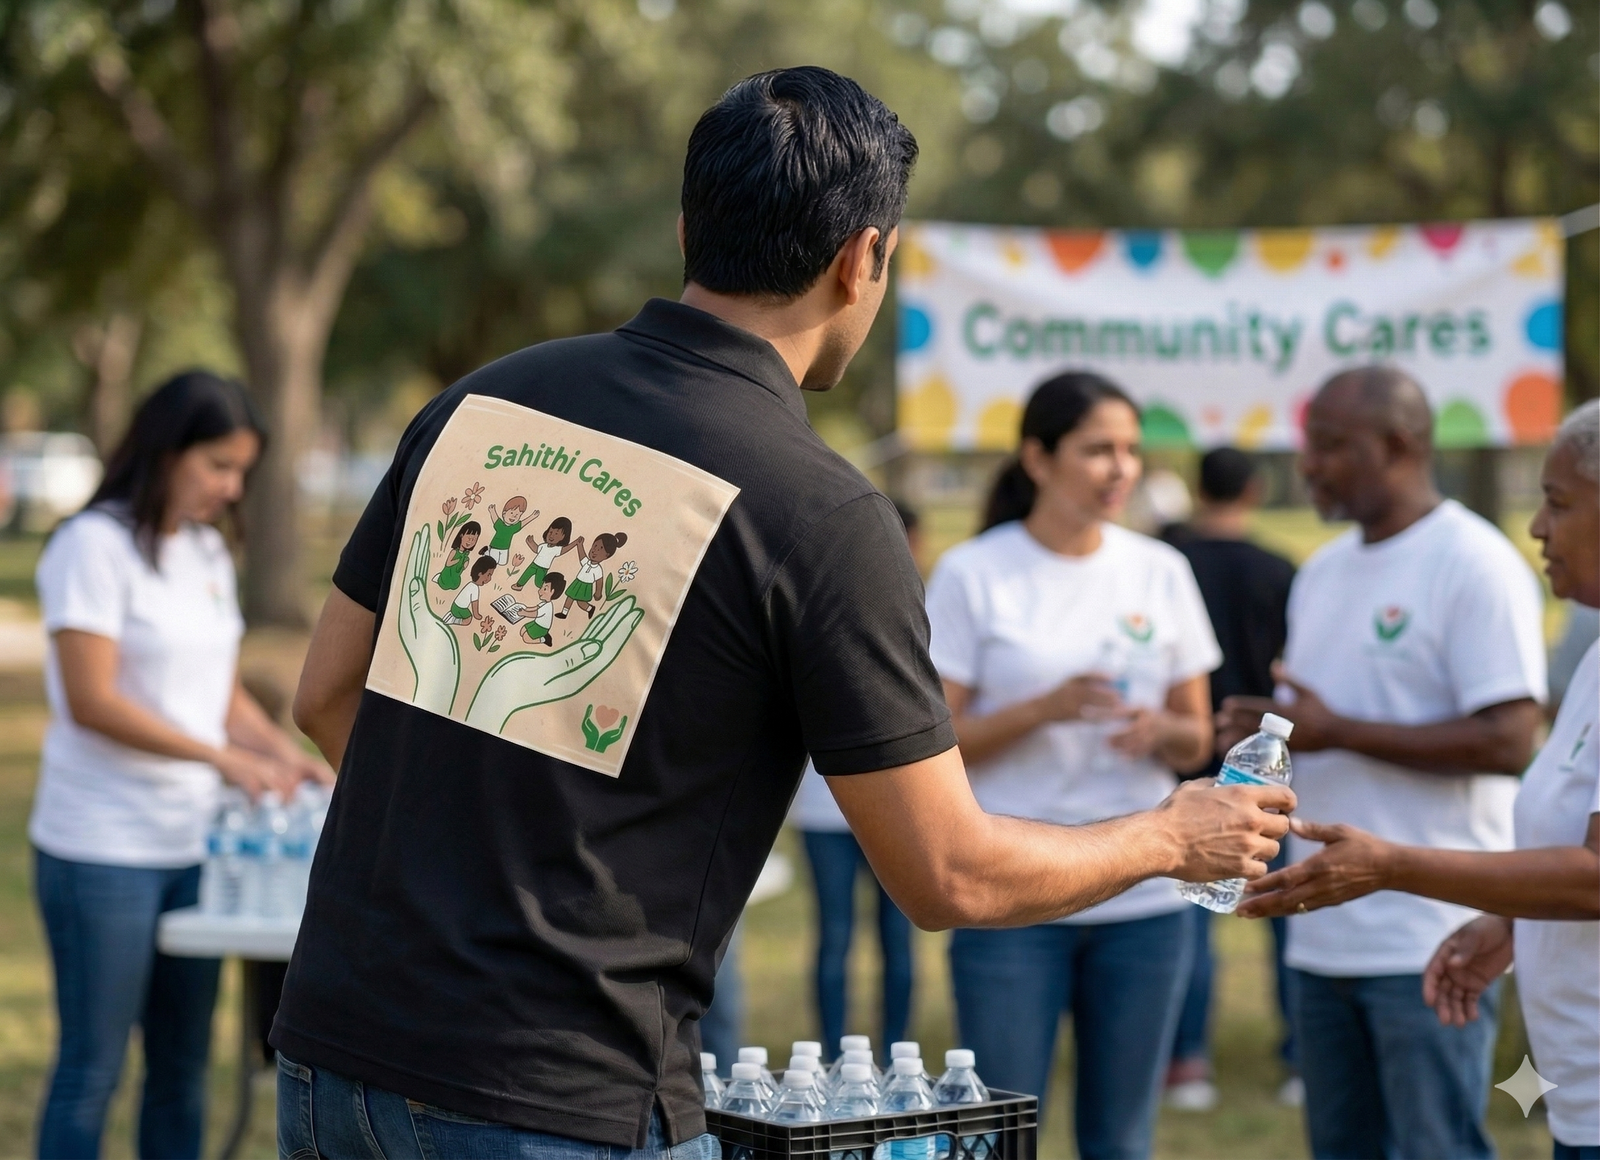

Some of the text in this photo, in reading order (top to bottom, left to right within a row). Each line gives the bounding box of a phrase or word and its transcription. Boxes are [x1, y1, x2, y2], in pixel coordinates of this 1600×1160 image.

[964, 301, 1491, 371] Community Cares
[484, 443, 642, 517] Sahithi Cares
